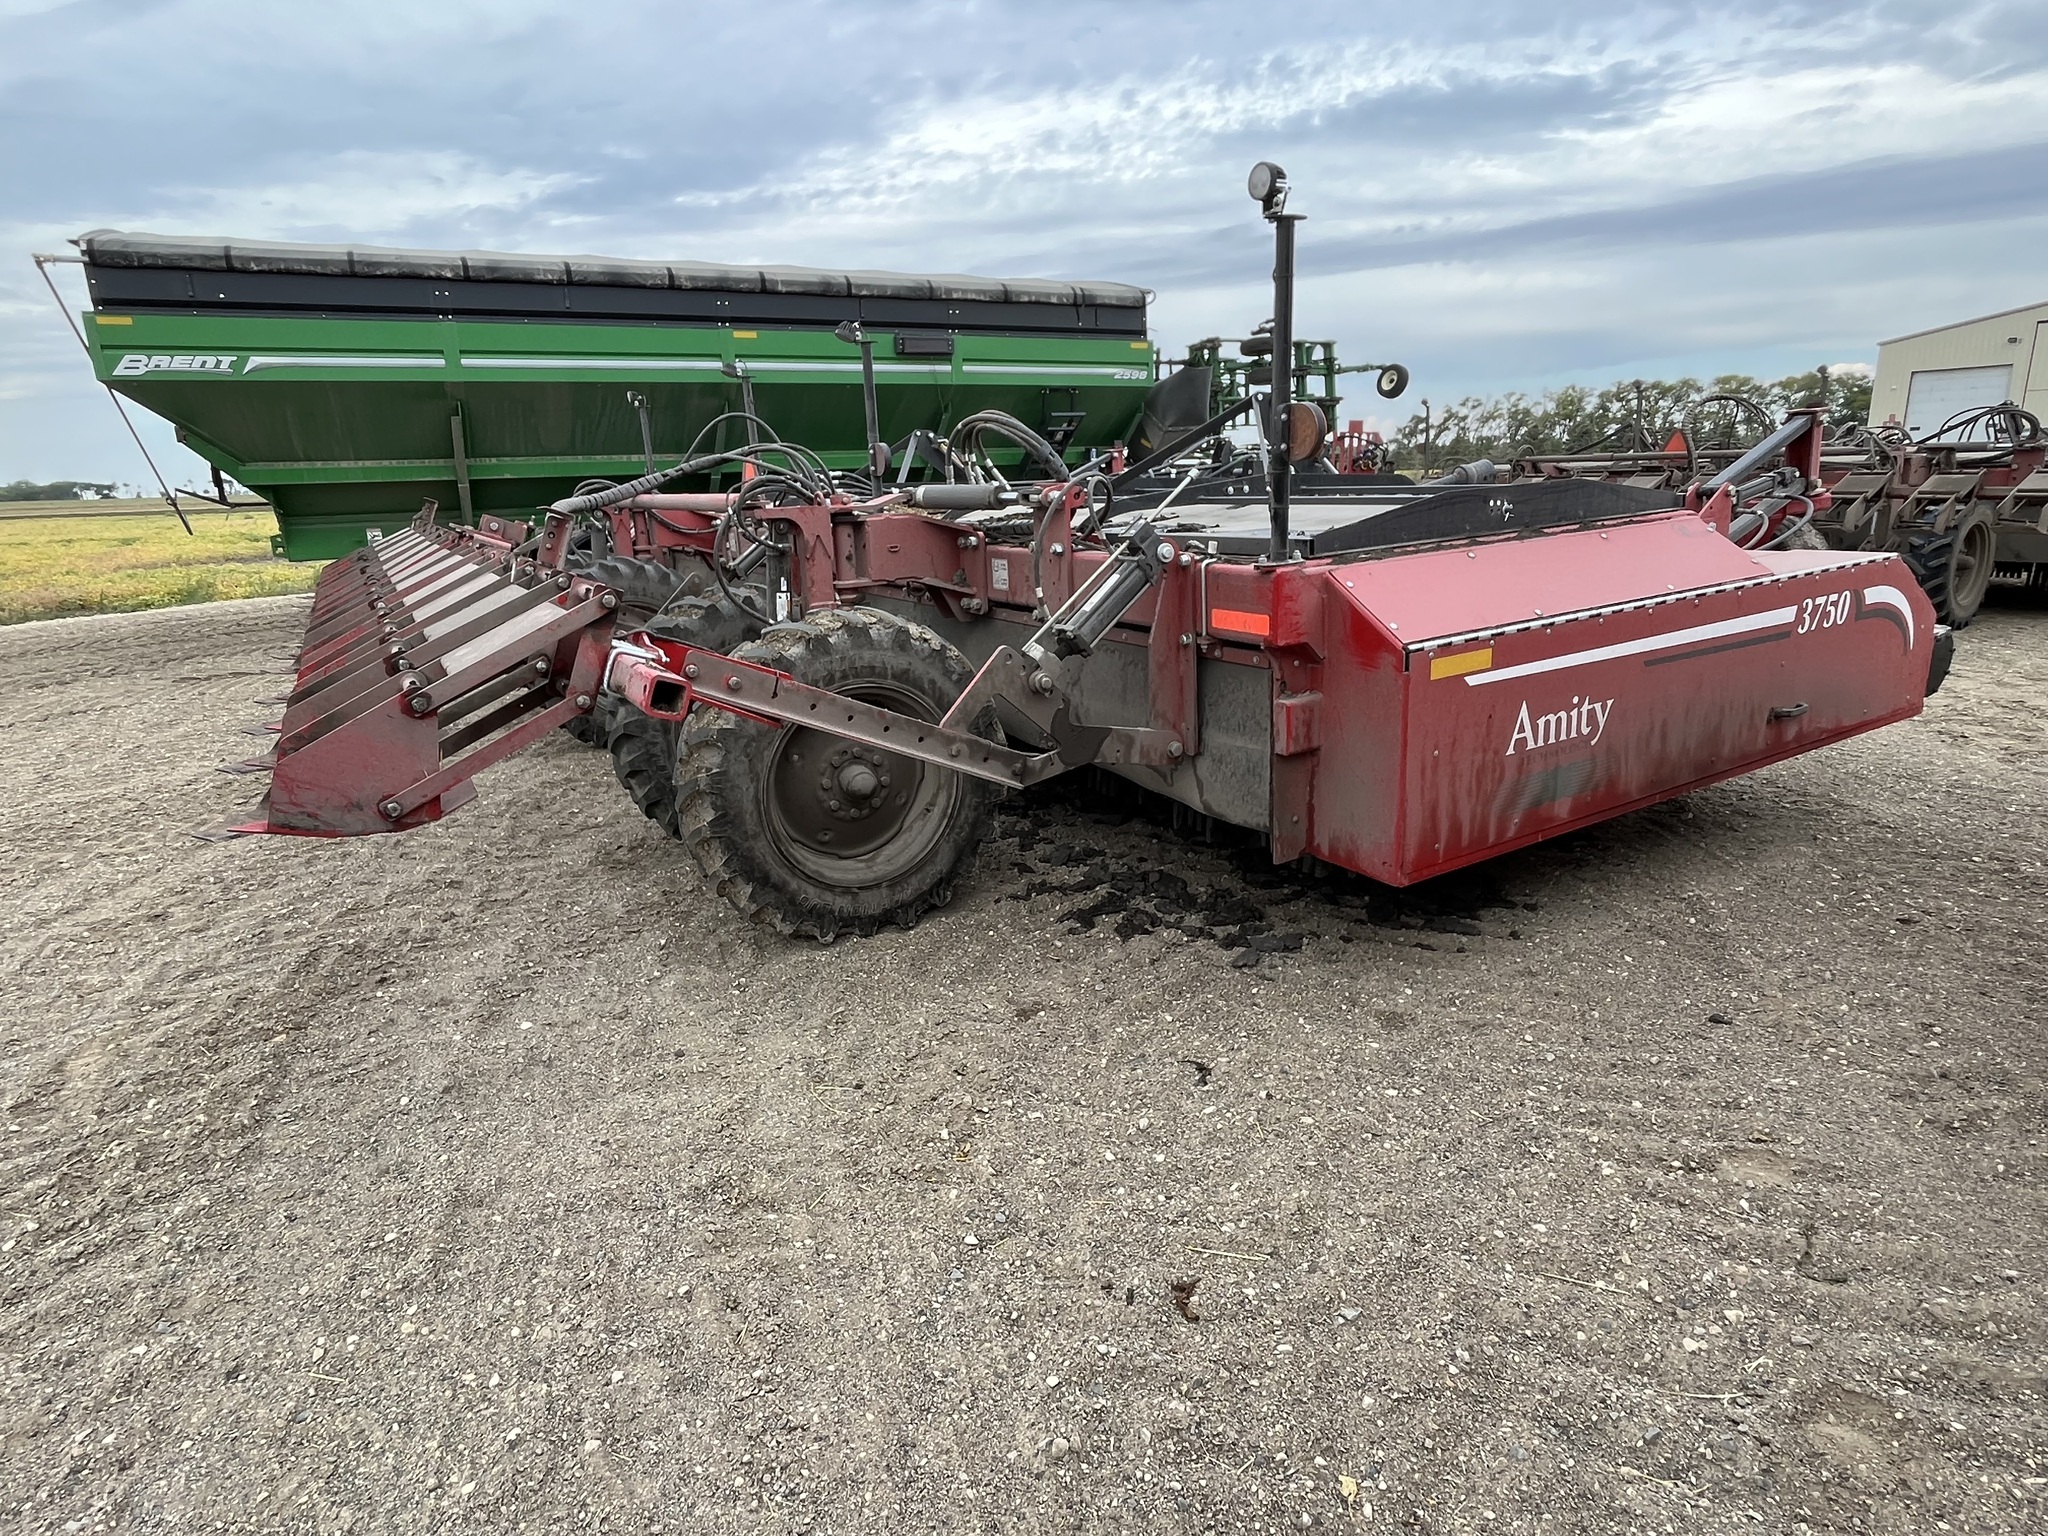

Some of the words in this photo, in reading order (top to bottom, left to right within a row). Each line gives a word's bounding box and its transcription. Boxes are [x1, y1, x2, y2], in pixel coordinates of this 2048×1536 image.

[112, 355, 238, 376] BRENT
[1796, 590, 1852, 635] 3750
[1505, 695, 1615, 756] Amity
